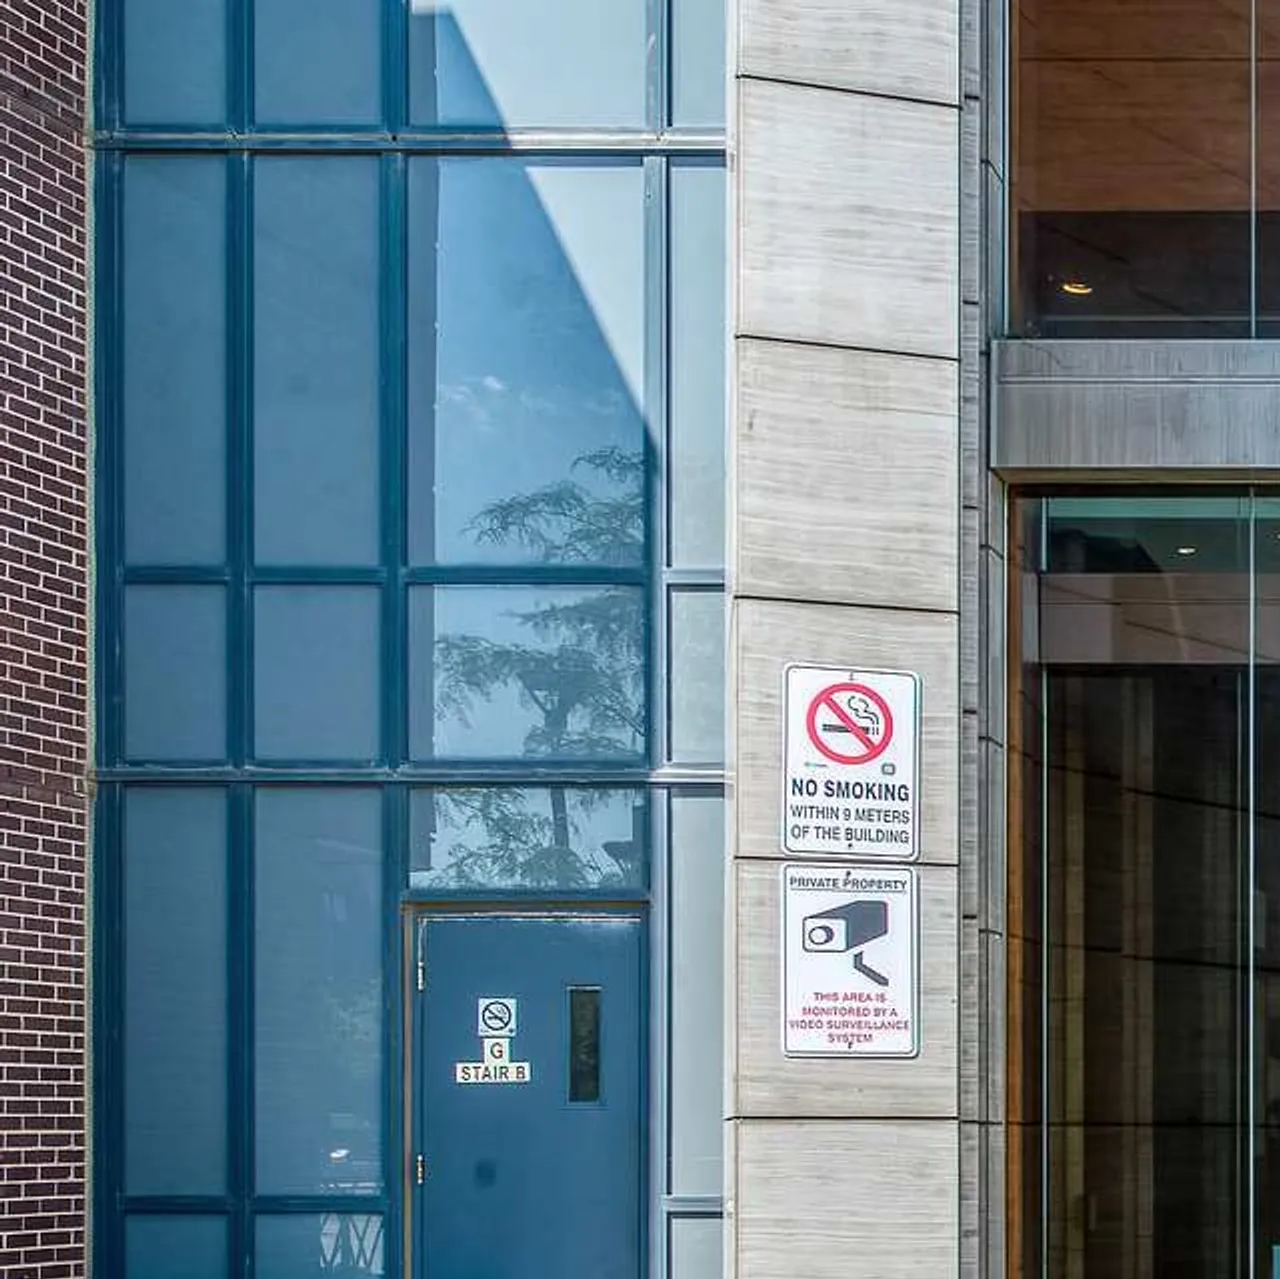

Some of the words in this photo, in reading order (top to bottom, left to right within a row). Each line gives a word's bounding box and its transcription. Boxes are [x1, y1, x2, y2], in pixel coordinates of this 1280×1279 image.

[791, 778, 818, 796] NO
[824, 780, 910, 801] SMOKING
[790, 804, 839, 821] WITHIN
[843, 808, 851, 821] 9
[854, 808, 910, 824] METERS
[790, 825, 809, 840] OF
[814, 826, 840, 841] THE
[845, 827, 910, 843] BUILDING
[789, 876, 838, 889] PRIVATE
[842, 878, 908, 890] PROPERTY
[813, 992, 839, 1002] THIS
[843, 992, 872, 1002] AREA
[876, 993, 886, 1002] IS
[802, 1006, 870, 1017] MONITORED
[874, 1007, 888, 1017] BY
[890, 1007, 898, 1017] A
[789, 1019, 823, 1030] VIDEO
[826, 1019, 909, 1031] SURVEILLANCE
[828, 1033, 873, 1044] SYSTEM
[490, 1042, 504, 1059] G
[461, 1066, 510, 1081] STAIR
[515, 1066, 526, 1080] B
